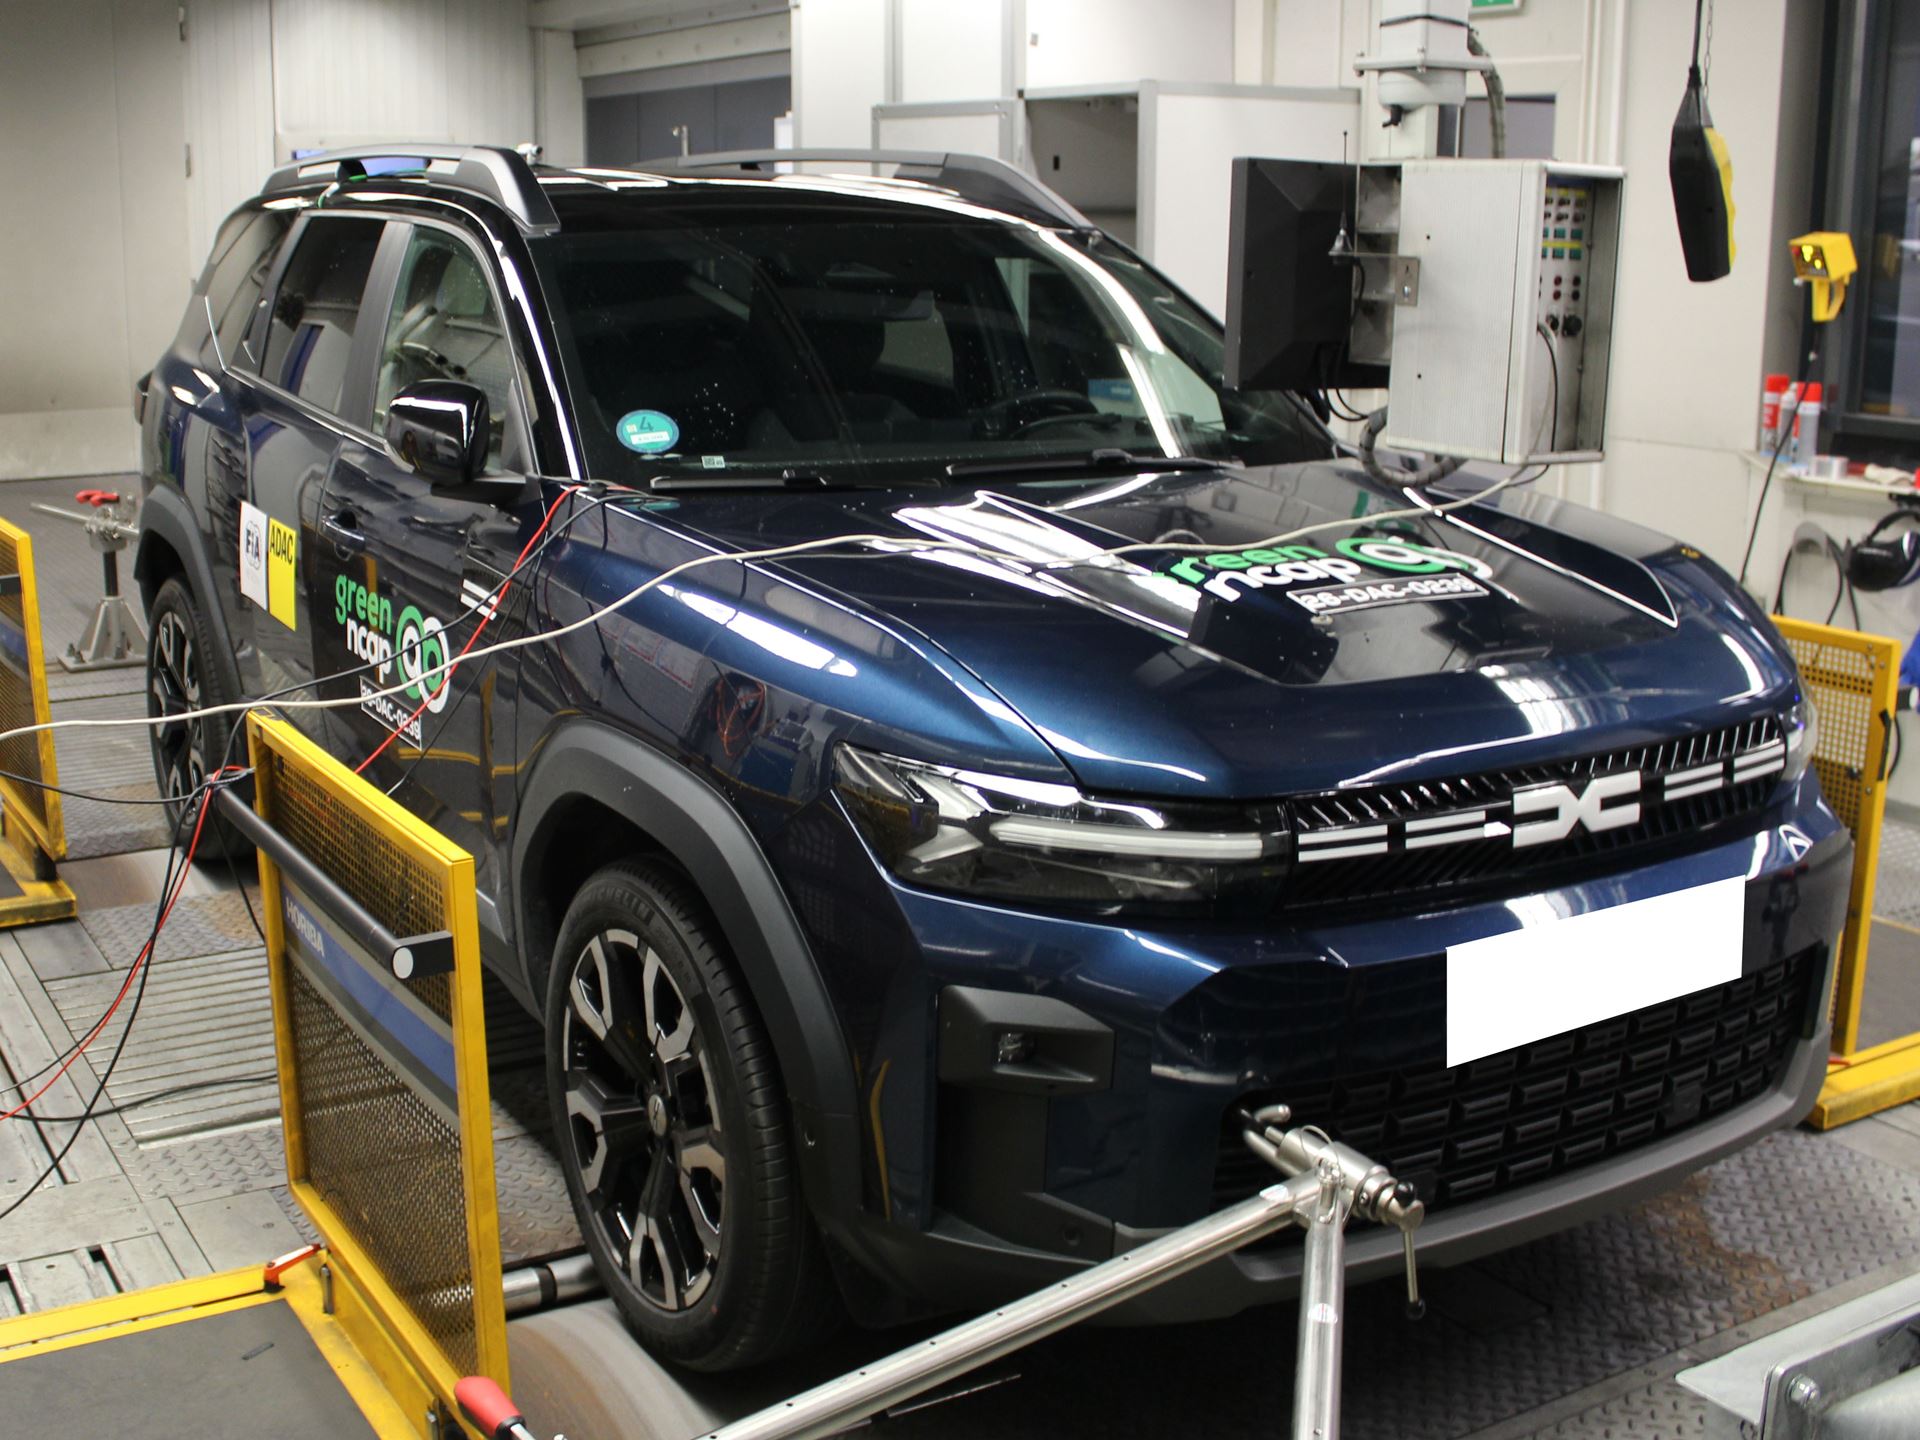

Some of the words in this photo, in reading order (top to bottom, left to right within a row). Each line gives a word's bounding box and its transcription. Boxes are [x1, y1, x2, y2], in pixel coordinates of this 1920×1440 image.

[639, 416, 655, 432] 4
[245, 528, 261, 561] FIA
[270, 525, 294, 566] ADAC
[1152, 545, 1328, 592] reen
[1203, 557, 1361, 602] ncap
[335, 574, 392, 636] green
[347, 617, 392, 685] ncap
[285, 896, 325, 958] HORIBA
